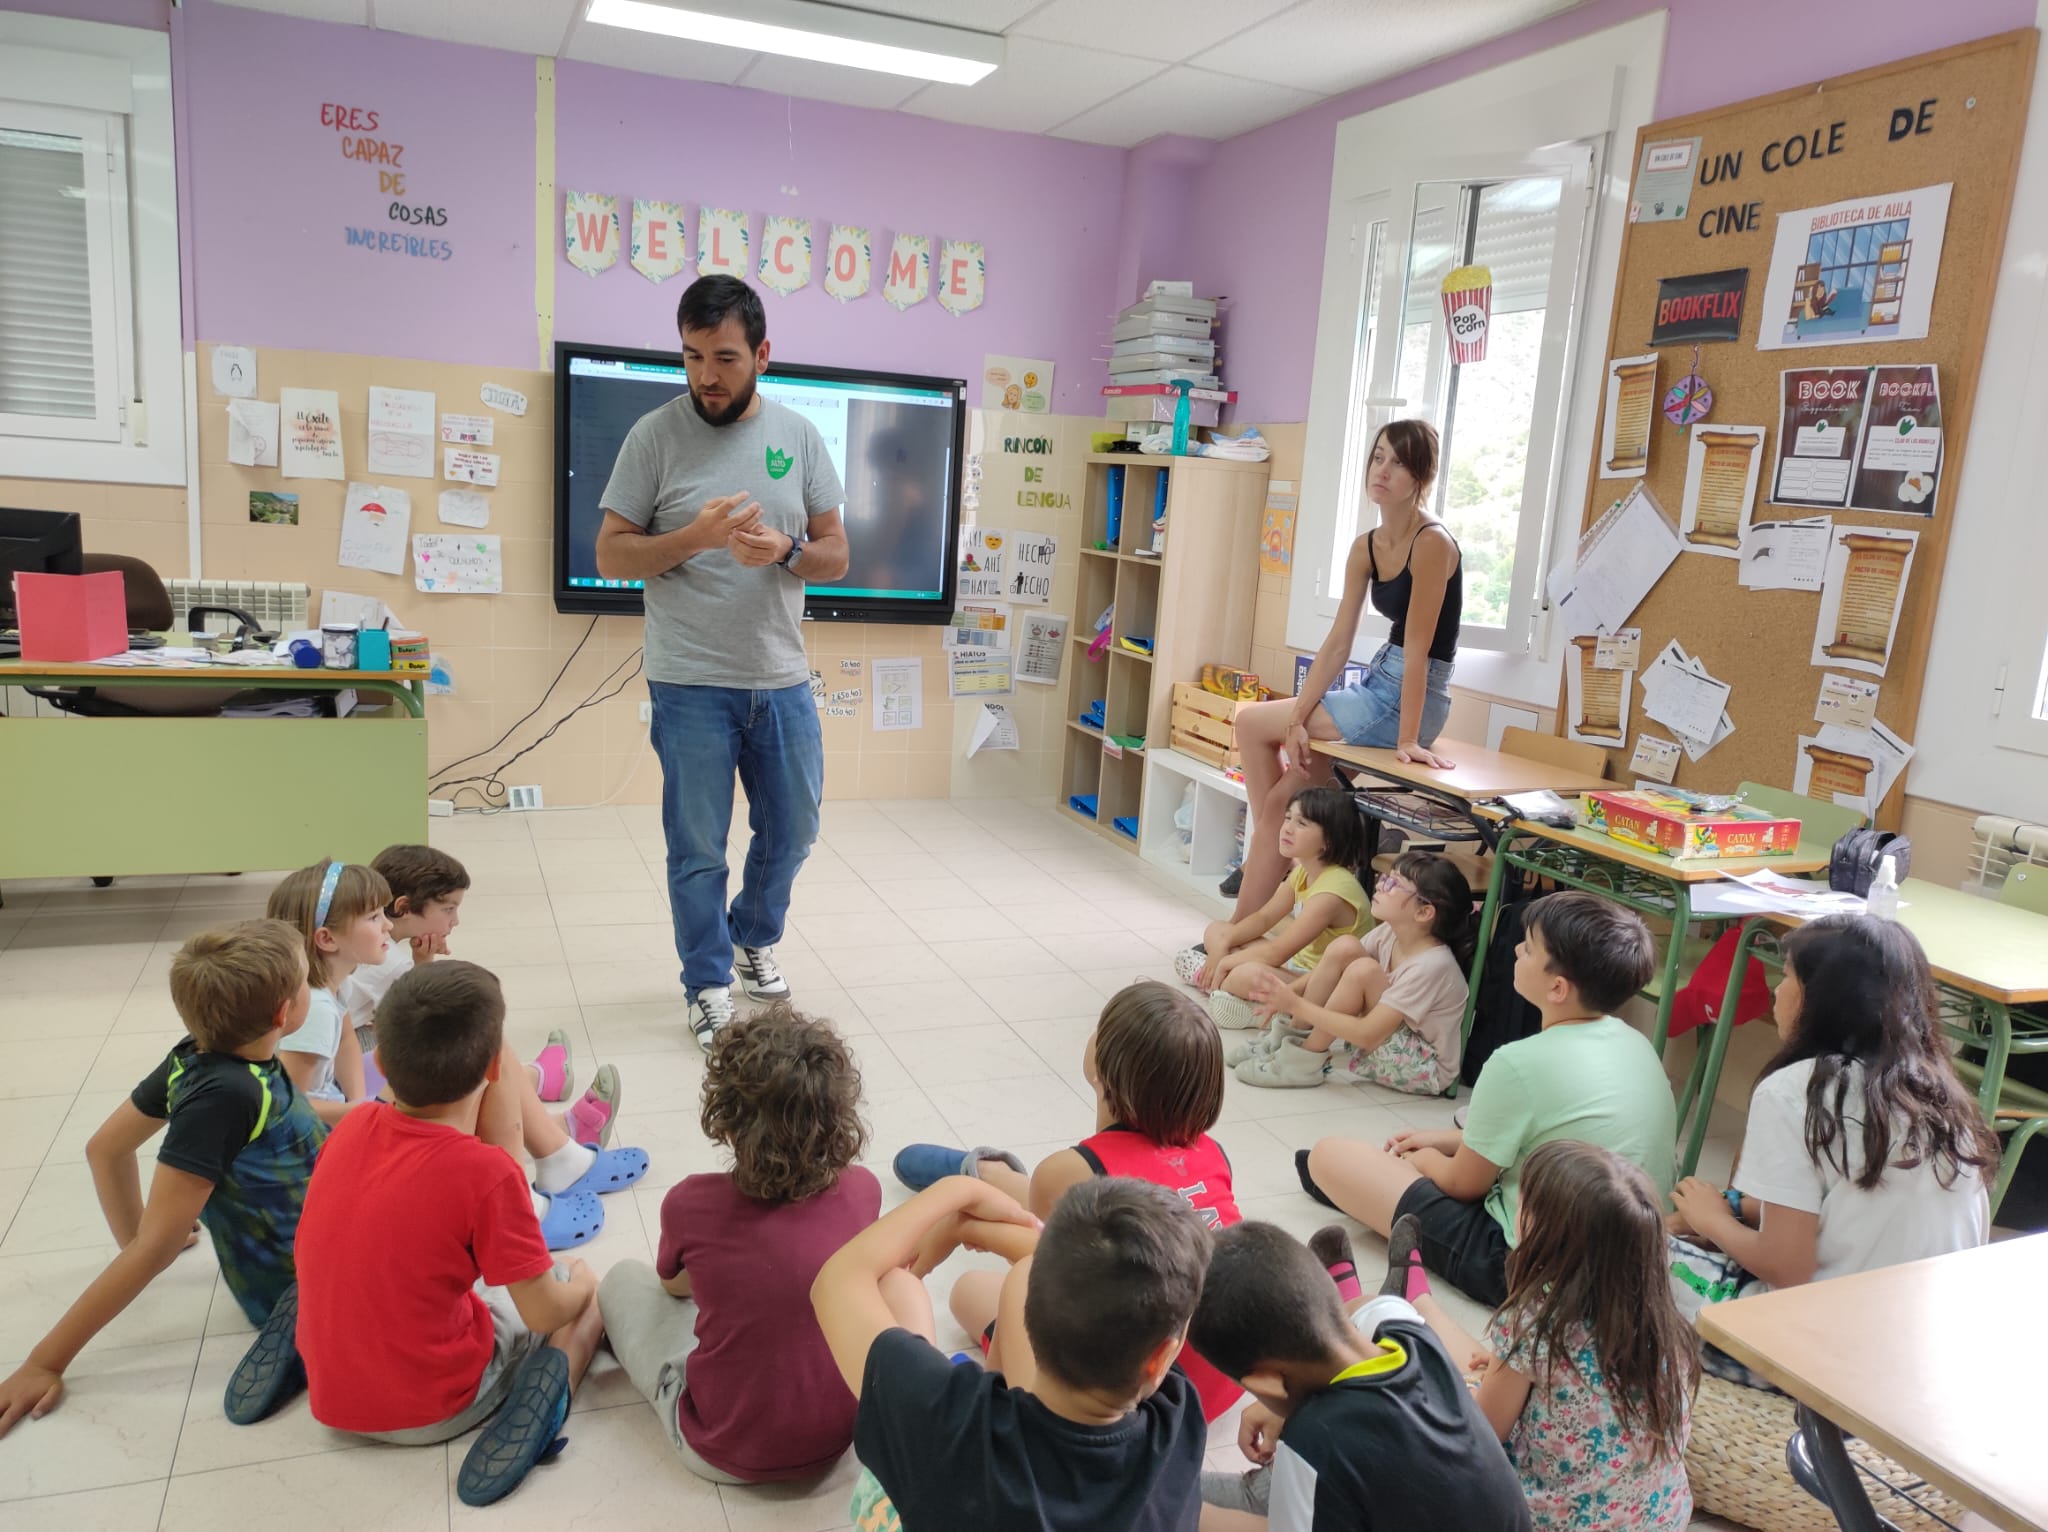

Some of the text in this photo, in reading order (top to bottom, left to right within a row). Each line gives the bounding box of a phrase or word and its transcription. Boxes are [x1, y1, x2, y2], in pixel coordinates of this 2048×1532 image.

[321, 103, 379, 131] ERES
[341, 136, 404, 168] CAPAZ
[1700, 98, 1939, 186] UN COLE DE
[379, 170, 405, 196] DE
[388, 202, 448, 226] COSAS
[1698, 200, 1762, 239] CINE
[1811, 201, 1912, 232] BIBLIOTECA DE AULA
[575, 211, 969, 296] WELCOME
[1657, 289, 1743, 327] BOOKFLIX
[1453, 312, 1477, 327] Pop
[1456, 320, 1486, 335] Corn
[1798, 380, 1860, 399] BOOK
[1004, 435, 1052, 454] RINCÓN
[1024, 466, 1044, 483] DE
[1017, 490, 1071, 510] LENGUA
[984, 553, 1001, 573] AHÍ
[1019, 541, 1051, 565] HECHO
[971, 578, 987, 595] HAY
[1614, 814, 1640, 830] CATAN
[1727, 833, 1756, 844] CATAN
